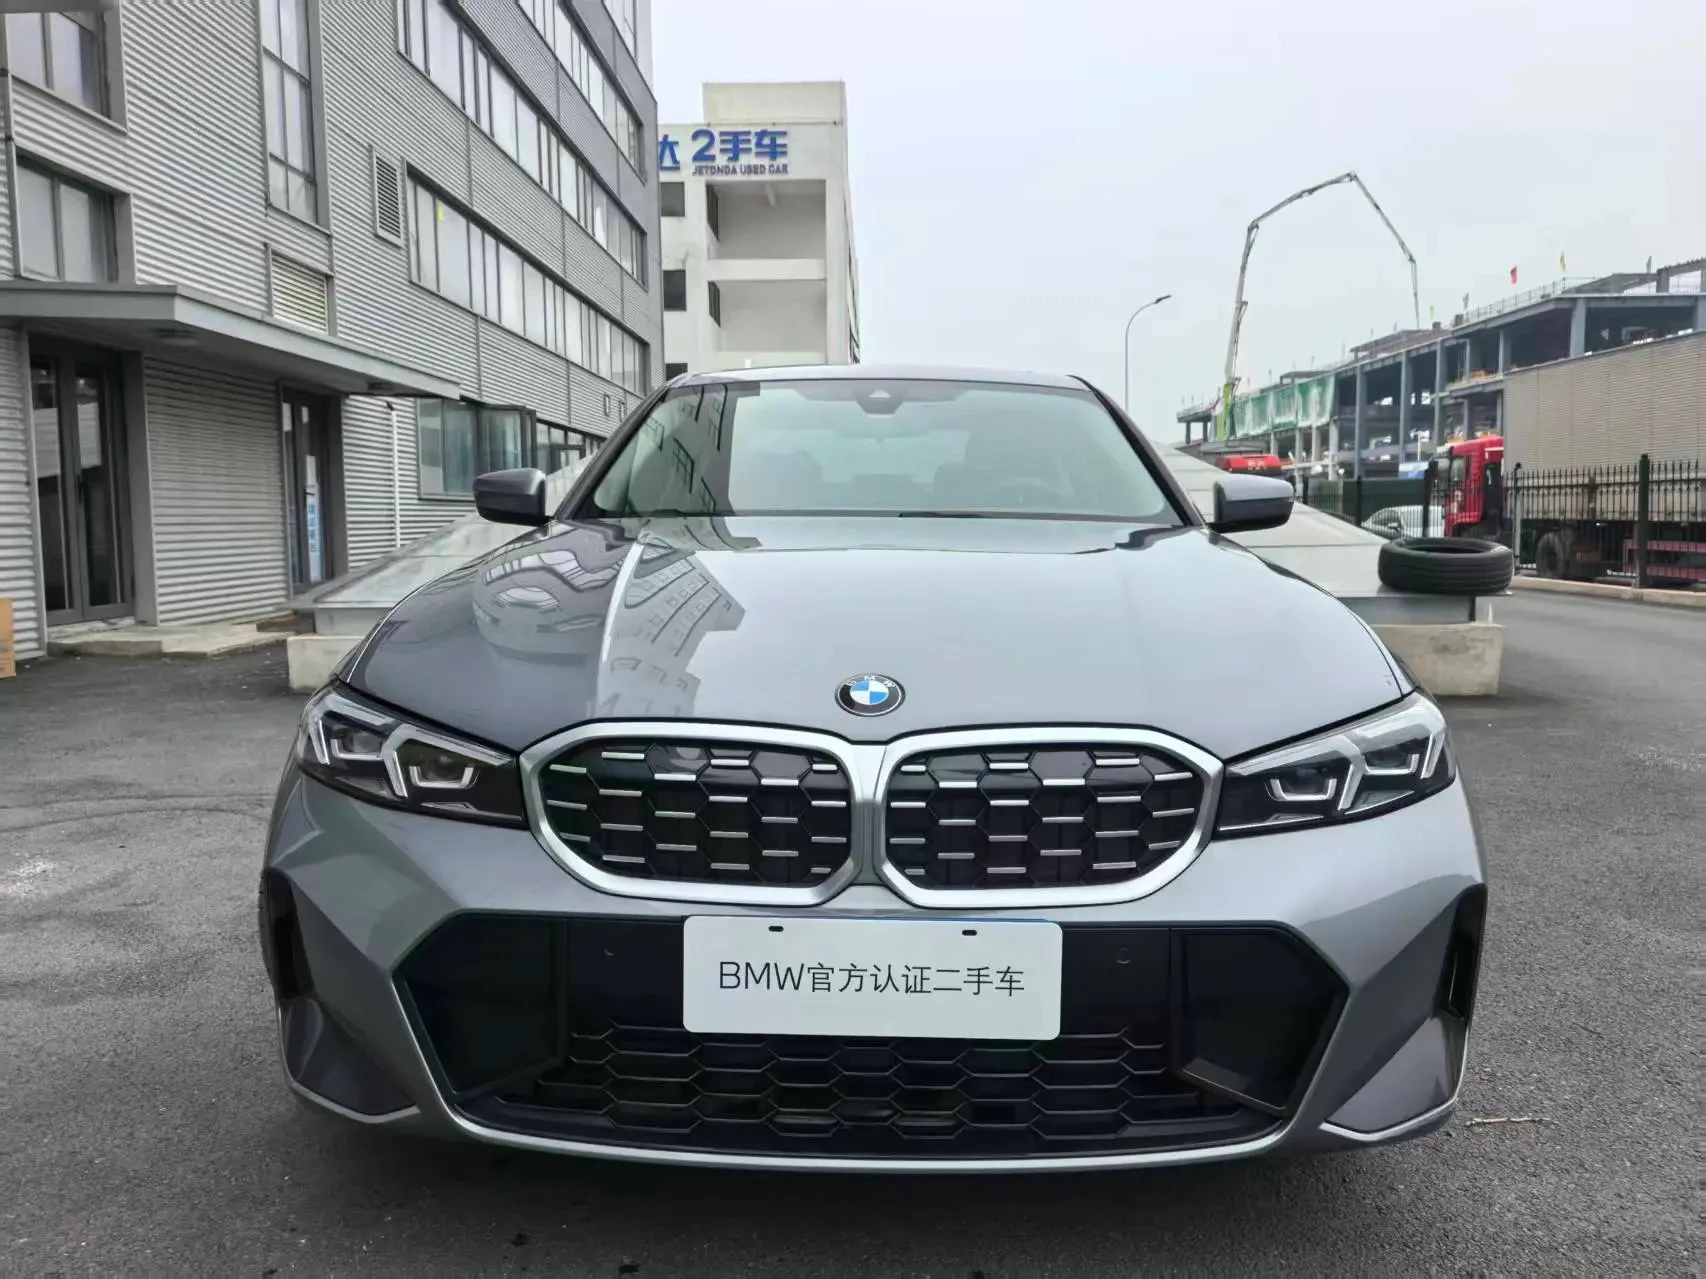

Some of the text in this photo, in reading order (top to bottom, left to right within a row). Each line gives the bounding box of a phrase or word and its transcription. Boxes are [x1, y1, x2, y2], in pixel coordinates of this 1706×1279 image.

[691, 129, 788, 161] 2手车
[741, 164, 766, 175] USED
[769, 163, 788, 174] CAR
[719, 961, 1025, 997] BMW官方认证二手车
